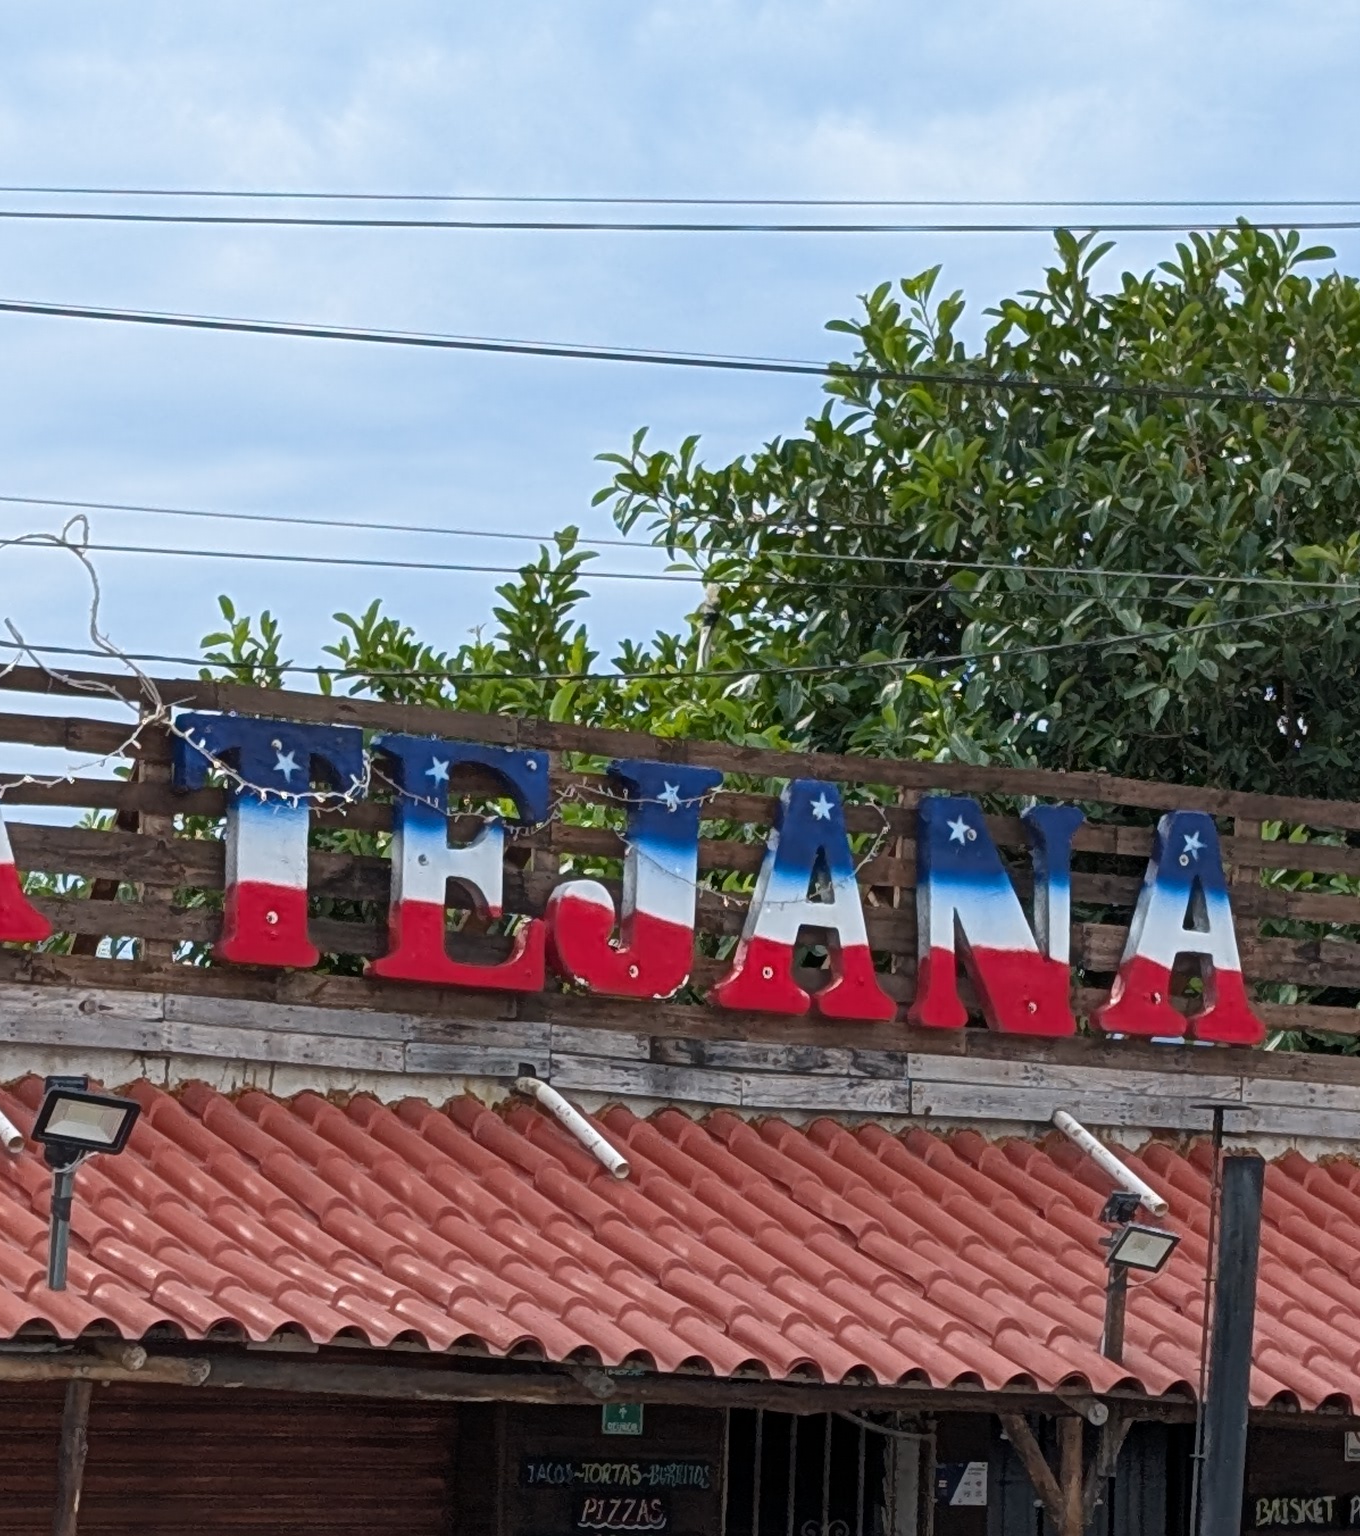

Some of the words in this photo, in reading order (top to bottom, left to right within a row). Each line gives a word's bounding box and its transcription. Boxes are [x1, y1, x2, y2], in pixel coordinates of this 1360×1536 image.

[173, 712, 1265, 1045] TEJANA
[581, 1498, 665, 1525] PIZZAS
[1255, 1495, 1336, 1528] BRISKET
